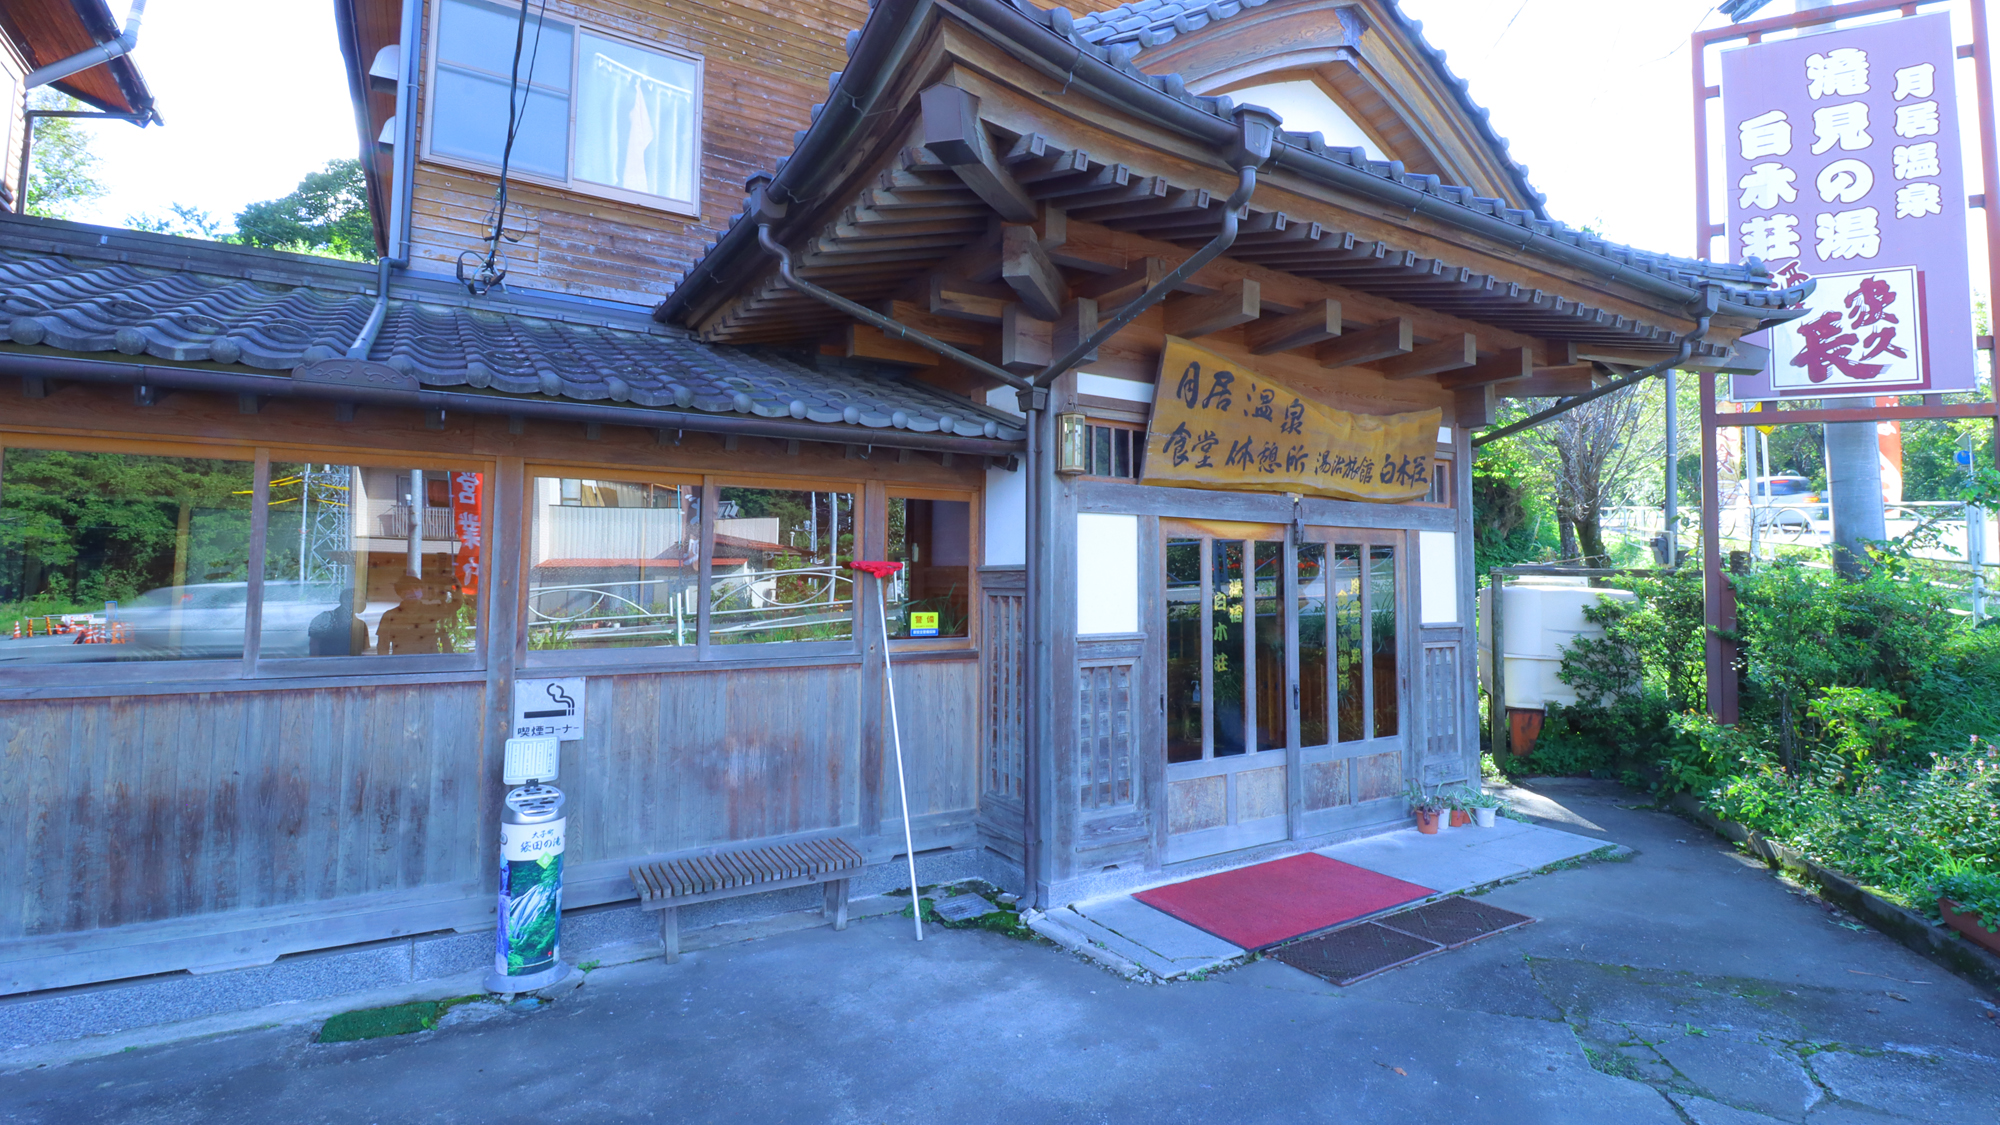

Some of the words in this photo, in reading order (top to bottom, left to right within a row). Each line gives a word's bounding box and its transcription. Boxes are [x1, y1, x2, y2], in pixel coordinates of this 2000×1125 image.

[1804, 47, 1881, 262] 滝見の湯
[1891, 62, 1943, 220] 月居温泉
[1176, 361, 1305, 435] 月居温泉
[1163, 422, 1219, 468] 食堂
[1225, 435, 1310, 475] 休憩所
[1315, 450, 1375, 485] 湯治旅館
[915, 615, 934, 624] 警備
[1214, 591, 1228, 673] 白木荘
[517, 724, 579, 738] 喫煙コーナー
[520, 836, 562, 853] 袋田の滝
[531, 828, 554, 839] 大子町
